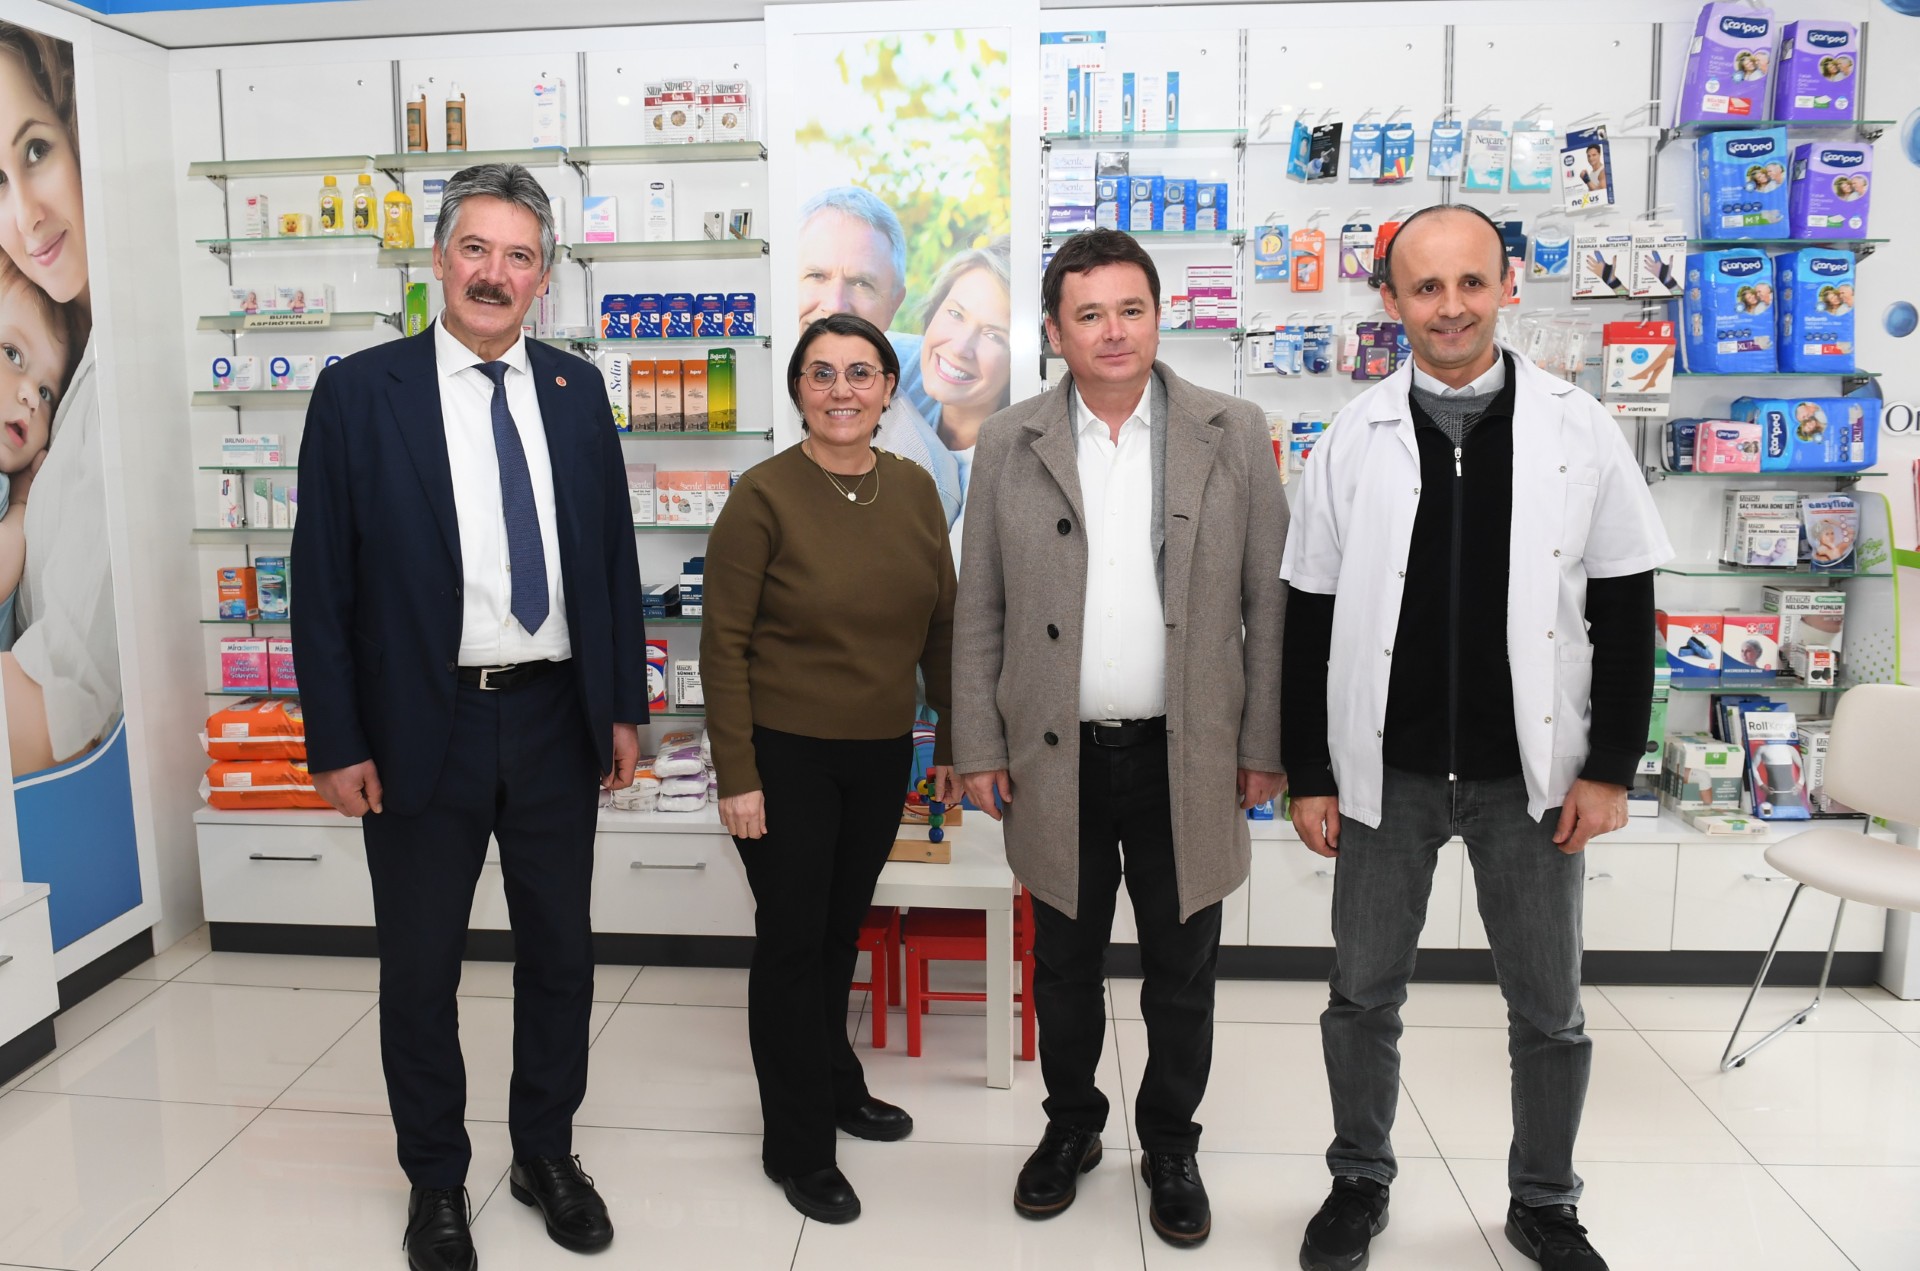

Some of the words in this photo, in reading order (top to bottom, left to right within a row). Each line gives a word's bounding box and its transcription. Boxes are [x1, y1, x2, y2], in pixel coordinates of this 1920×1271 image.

[1721, 260, 1761, 272] canped
[610, 360, 622, 392] Selin
[1808, 500, 1855, 510] easyflow
[1748, 721, 1768, 731] Roll
